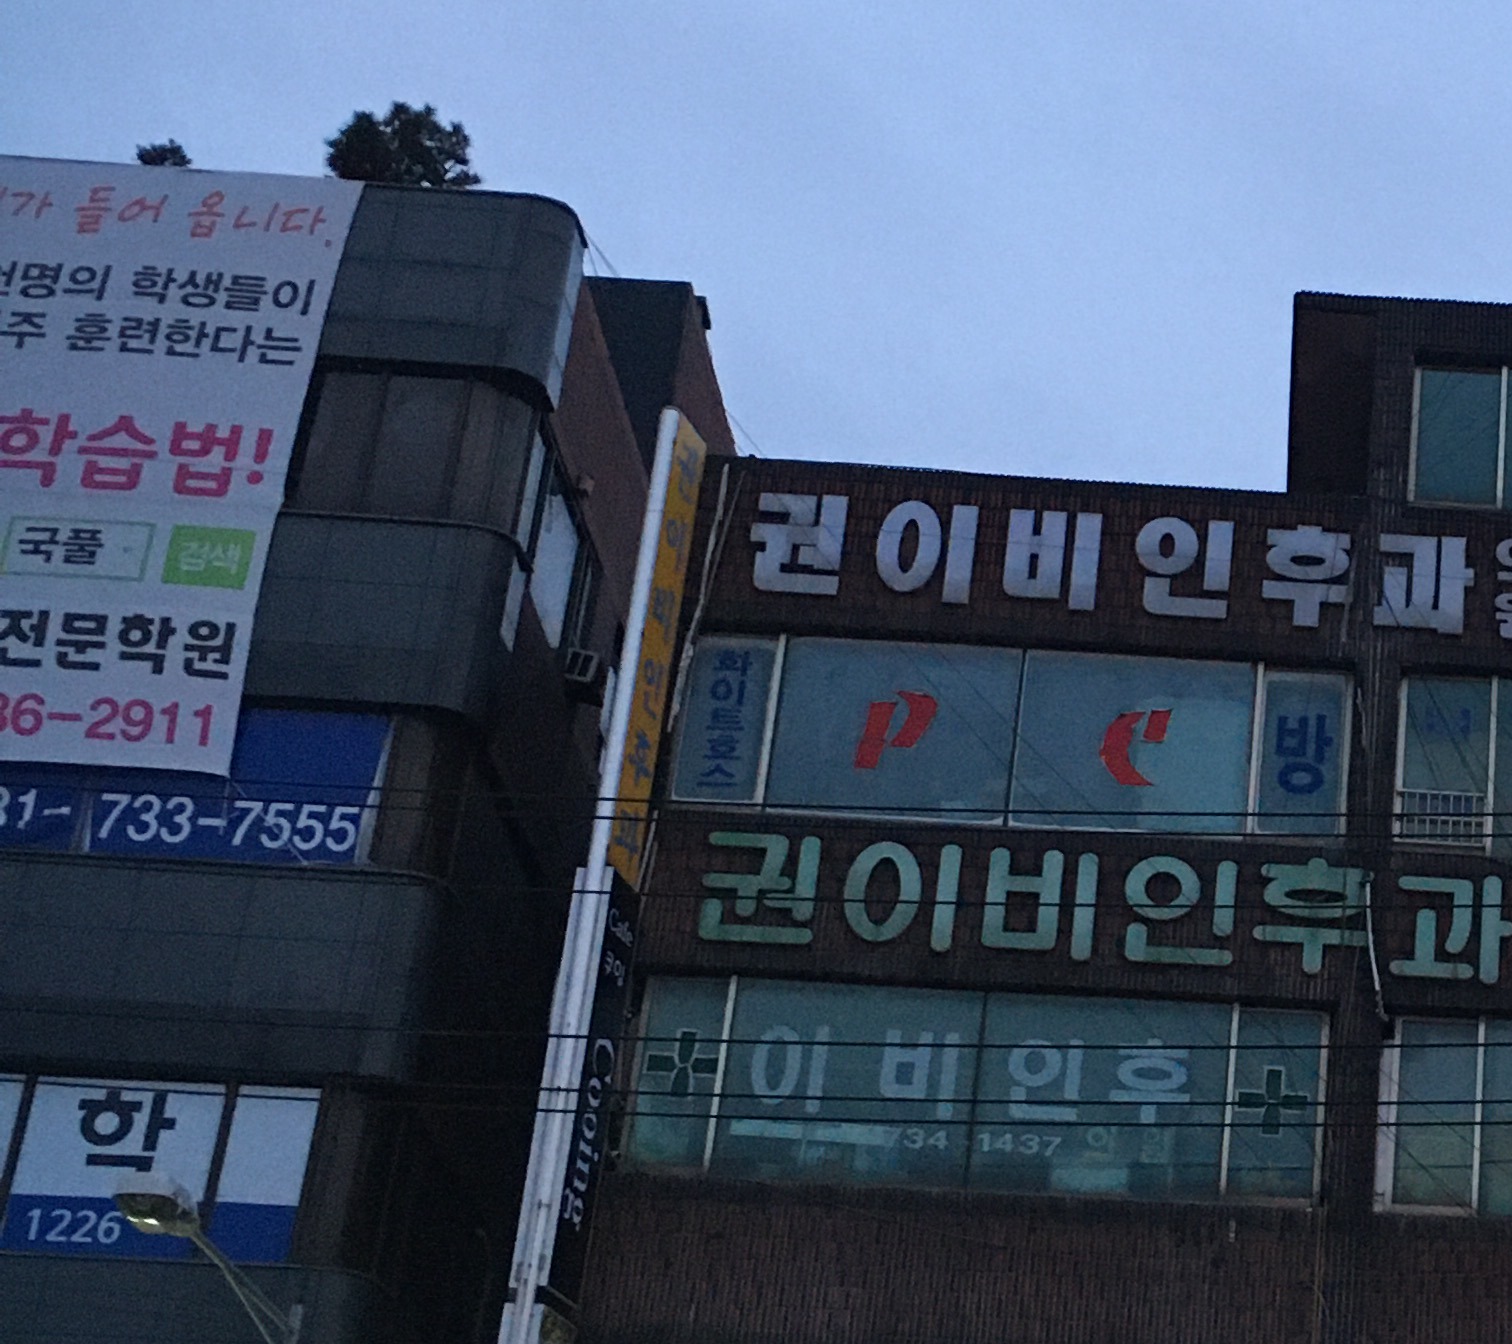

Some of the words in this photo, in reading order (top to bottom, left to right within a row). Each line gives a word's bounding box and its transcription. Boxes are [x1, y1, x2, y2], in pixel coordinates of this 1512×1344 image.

[131, 265, 316, 316] 학생들이
[65, 313, 303, 366] 훈련한다는
[0, 408, 274, 498] 학습법!
[179, 540, 241, 575] 검색
[749, 492, 1475, 636] 권이비인후과
[0, 609, 237, 680] 전문학원
[0, 692, 215, 747] 6-2911
[1276, 713, 1334, 796] 방
[97, 791, 360, 853] 733-7555
[749, 1024, 1192, 1125] 이비인후
[562, 1036, 616, 1233] Cooing
[977, 1132, 1063, 1157] 1437
